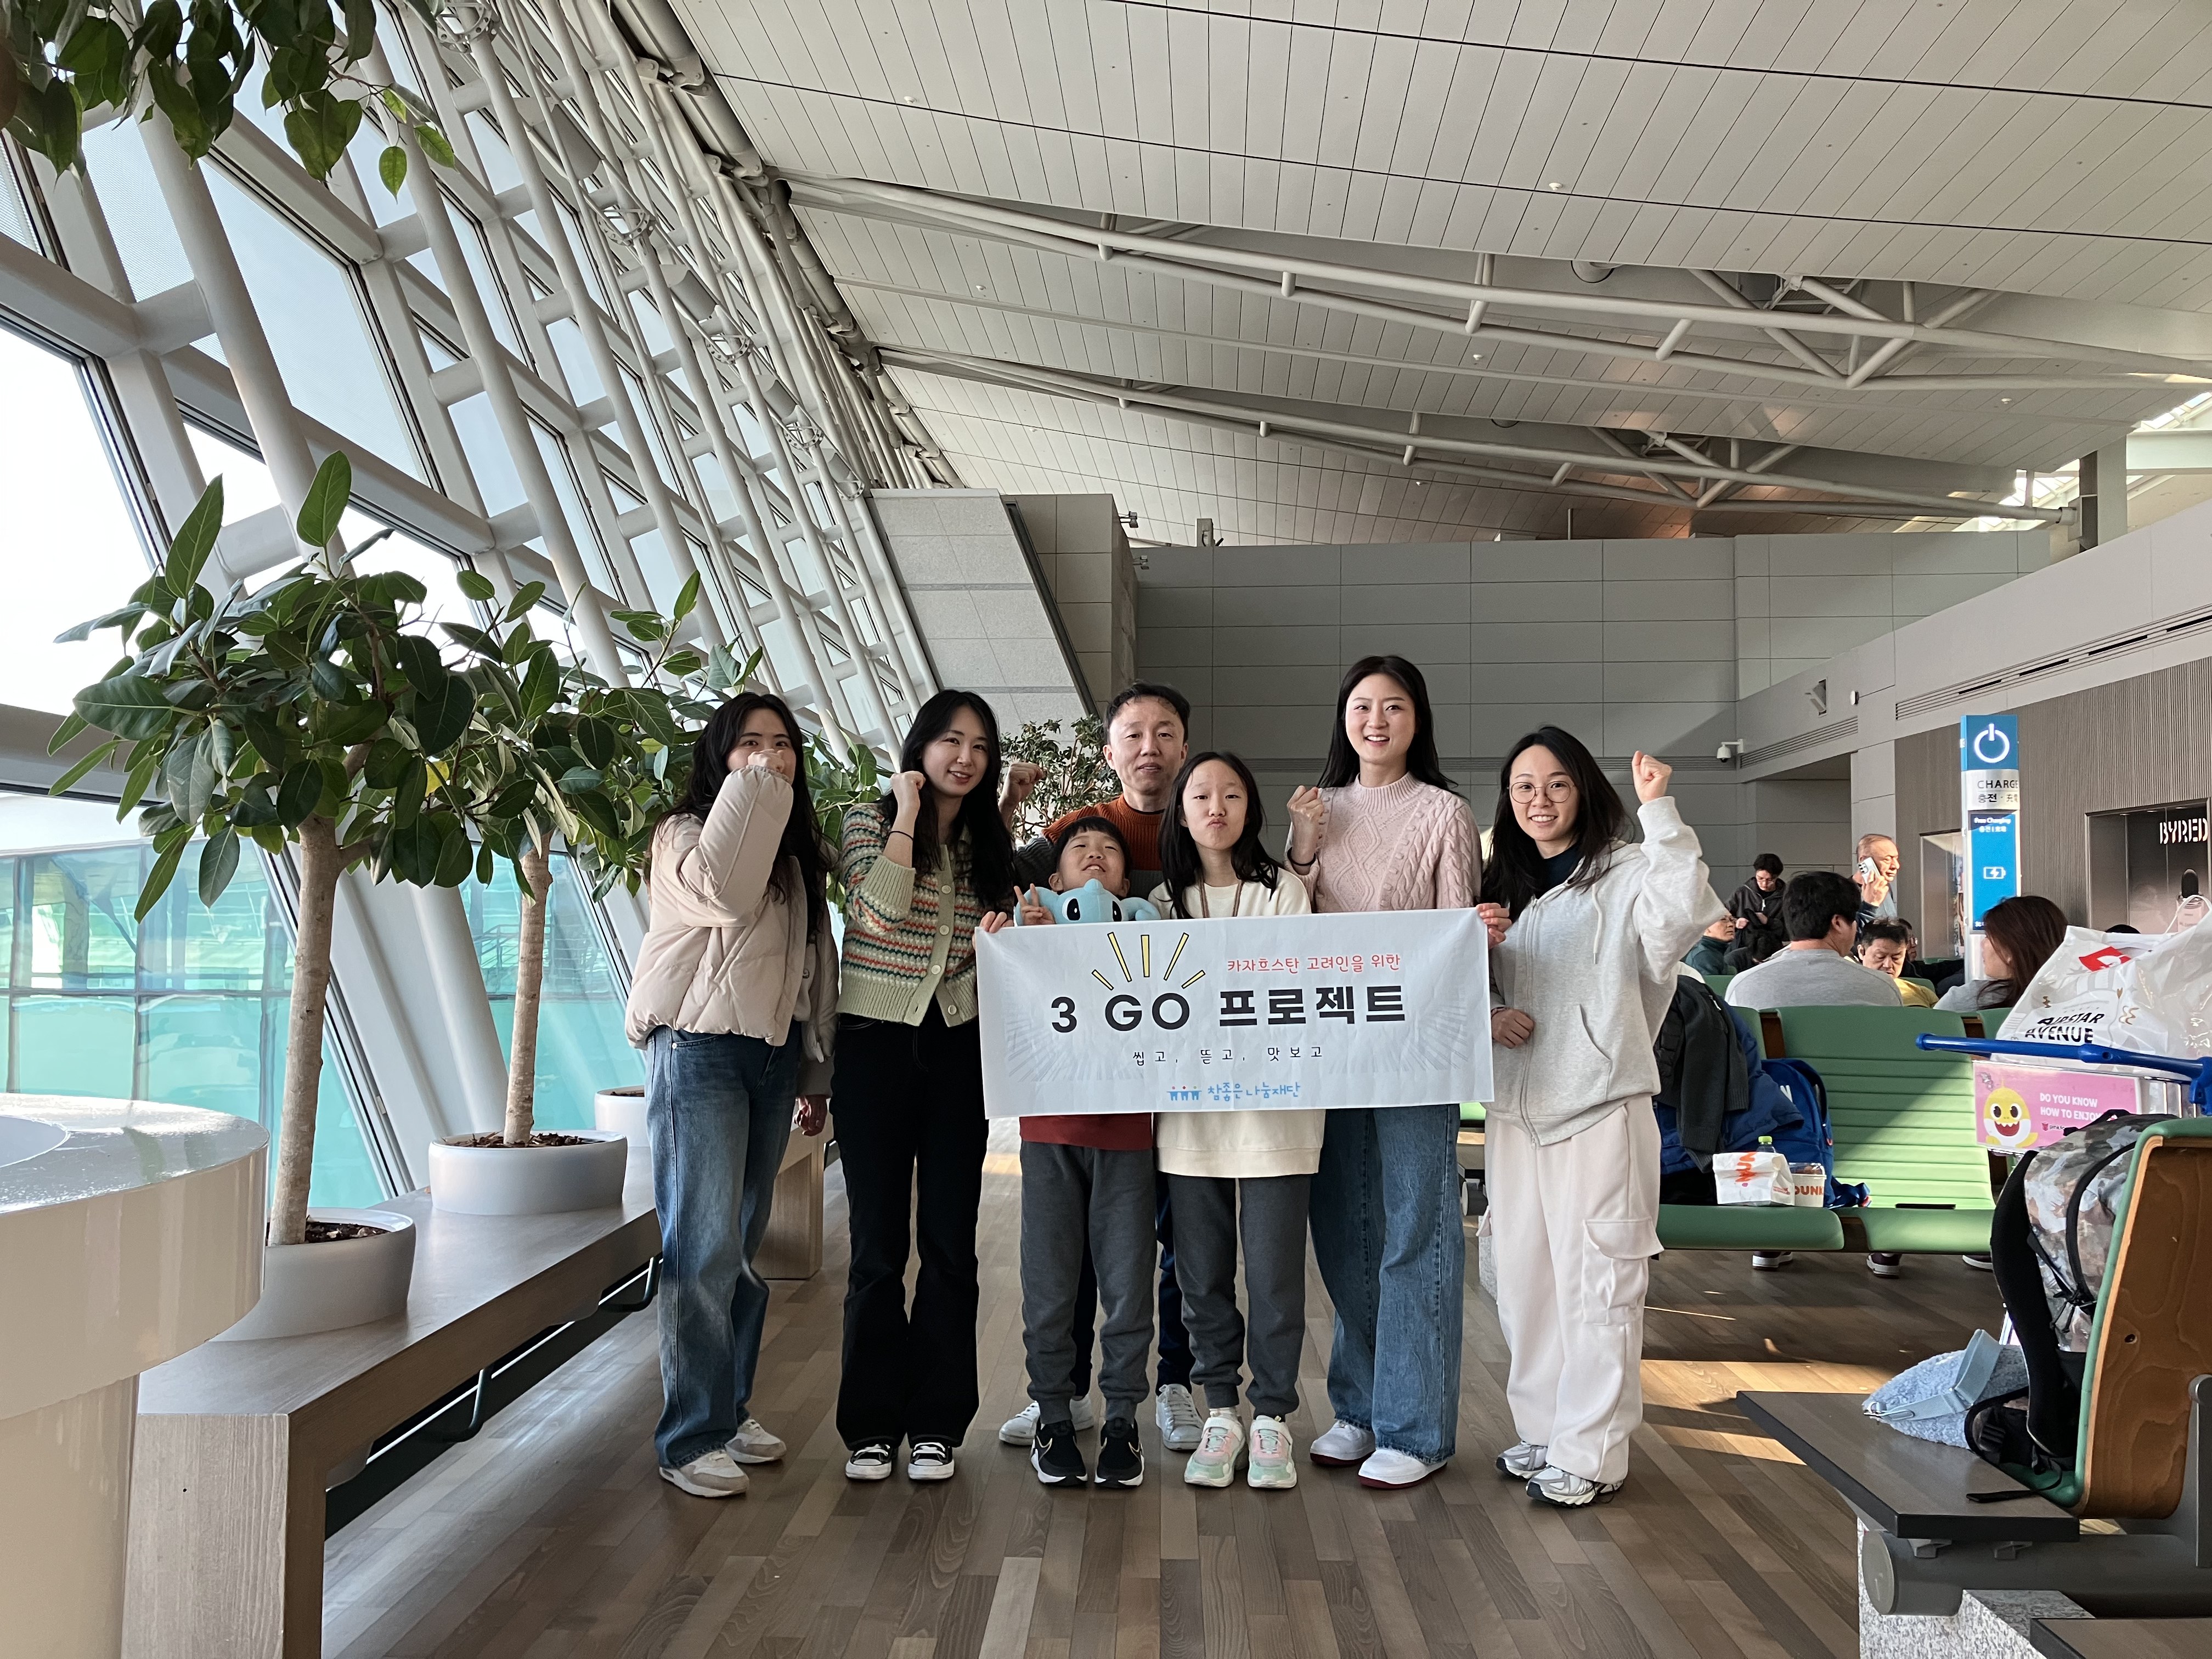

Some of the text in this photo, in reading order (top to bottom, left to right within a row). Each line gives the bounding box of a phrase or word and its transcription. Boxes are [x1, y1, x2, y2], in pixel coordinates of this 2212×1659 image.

[1977, 780, 2018, 788] CHARGE
[2159, 817, 2208, 844] BYRED
[1227, 954, 1401, 974] 카자흐스탄 고려인을 위한
[1051, 985, 1406, 1033] 3 GO 프로젝트
[2024, 1026, 2094, 1043] AVENUE
[1132, 1046, 1323, 1066] 씹고, 뜯고, 맛보고
[2040, 1092, 2098, 1108] DO YOU KNOW
[2040, 1106, 2059, 1117] HOW
[2061, 1109, 2072, 1119] TO
